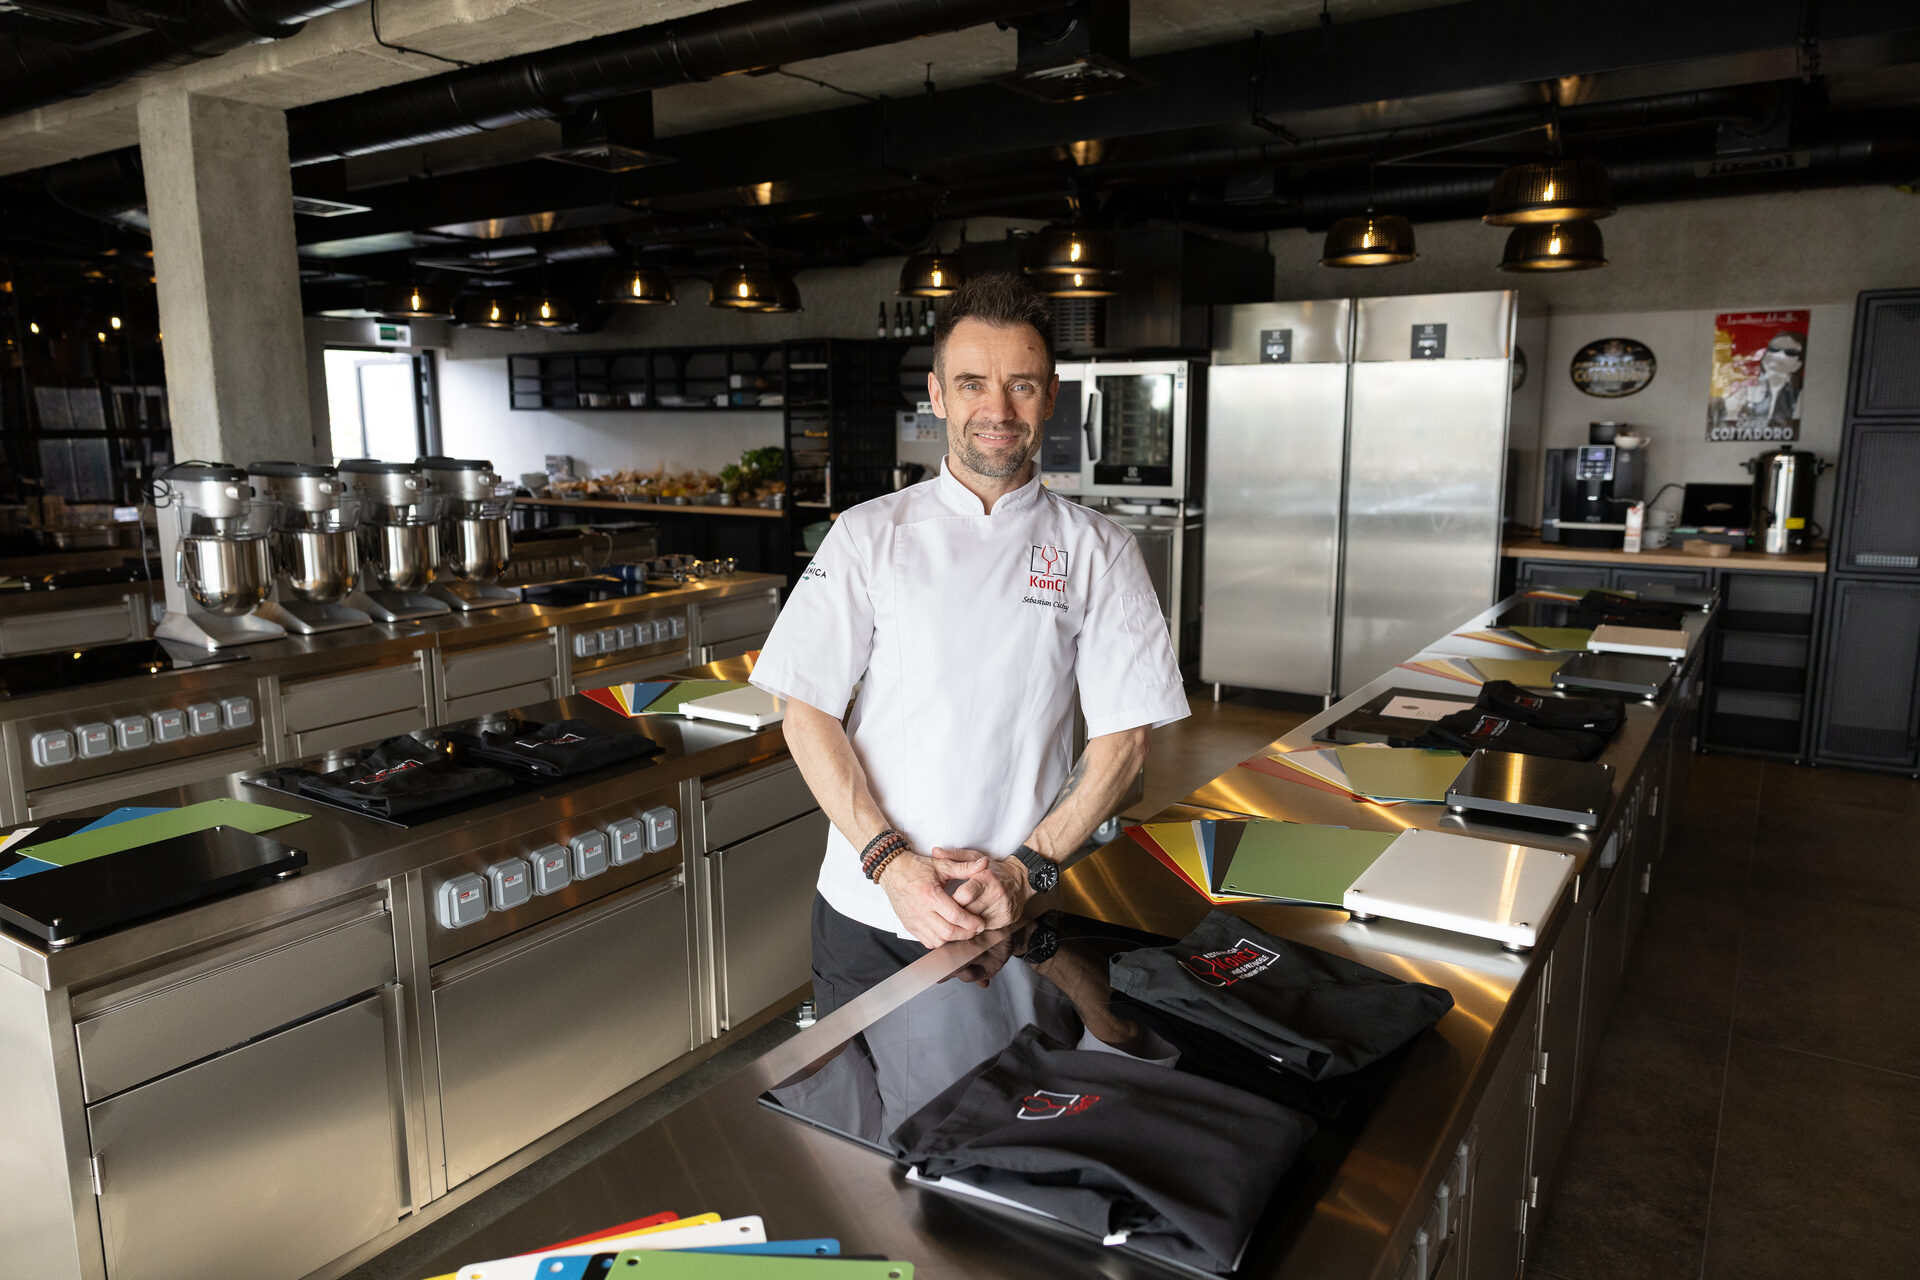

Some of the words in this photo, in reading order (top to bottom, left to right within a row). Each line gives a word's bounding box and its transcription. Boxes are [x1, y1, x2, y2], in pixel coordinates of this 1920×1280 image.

[1711, 427, 1794, 440] COSTADORO
[1029, 575, 1066, 592] KonCi
[1022, 596, 1052, 607] Sebastian
